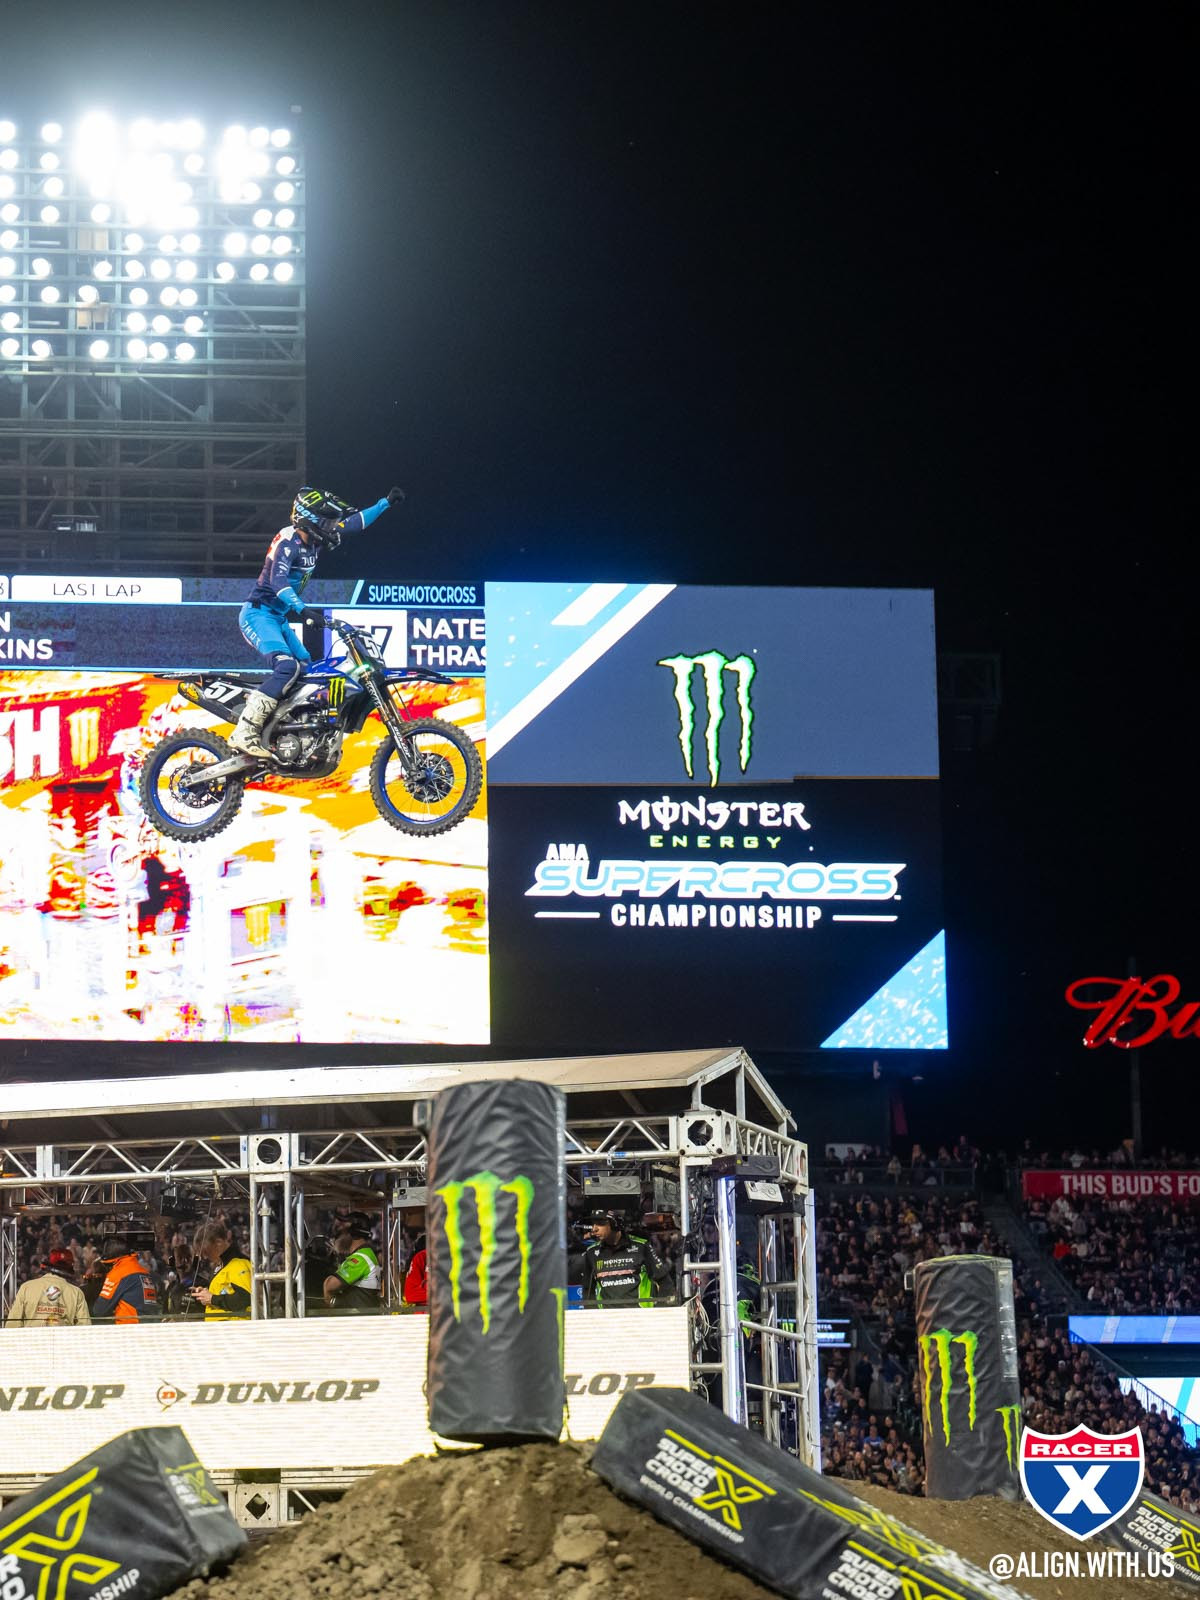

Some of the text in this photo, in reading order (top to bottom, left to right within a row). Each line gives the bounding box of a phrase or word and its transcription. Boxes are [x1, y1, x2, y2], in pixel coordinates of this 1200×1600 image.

[53, 583, 142, 598] LAST LAP
[368, 585, 476, 604] SUPERMOTOCROSS
[412, 617, 486, 640] NATE
[203, 681, 244, 704] 57
[617, 795, 813, 832] MONSTER
[546, 842, 590, 861] AMA
[649, 834, 784, 850] ENERGY
[525, 860, 907, 900] SUPERCROSS
[611, 902, 823, 929] CHAMPIONSHIP
[1060, 1174, 1107, 1195] THIS
[1111, 1174, 1173, 1196] BUD'S
[191, 1379, 380, 1406] DUNLOP
[654, 1450, 710, 1489] MOTO
[657, 1437, 718, 1480] SUPER
[645, 1458, 705, 1499] CROSS
[640, 1474, 745, 1543] WORLD CHAMPIONSHIP
[1136, 1506, 1182, 1537] SUPER
[1122, 1531, 1149, 1551] WORLD
[1127, 1520, 1173, 1550] CROSS
[1134, 1515, 1177, 1543] MOTO
[836, 1562, 896, 1599] MOTO
[839, 1549, 903, 1590] SUPER
